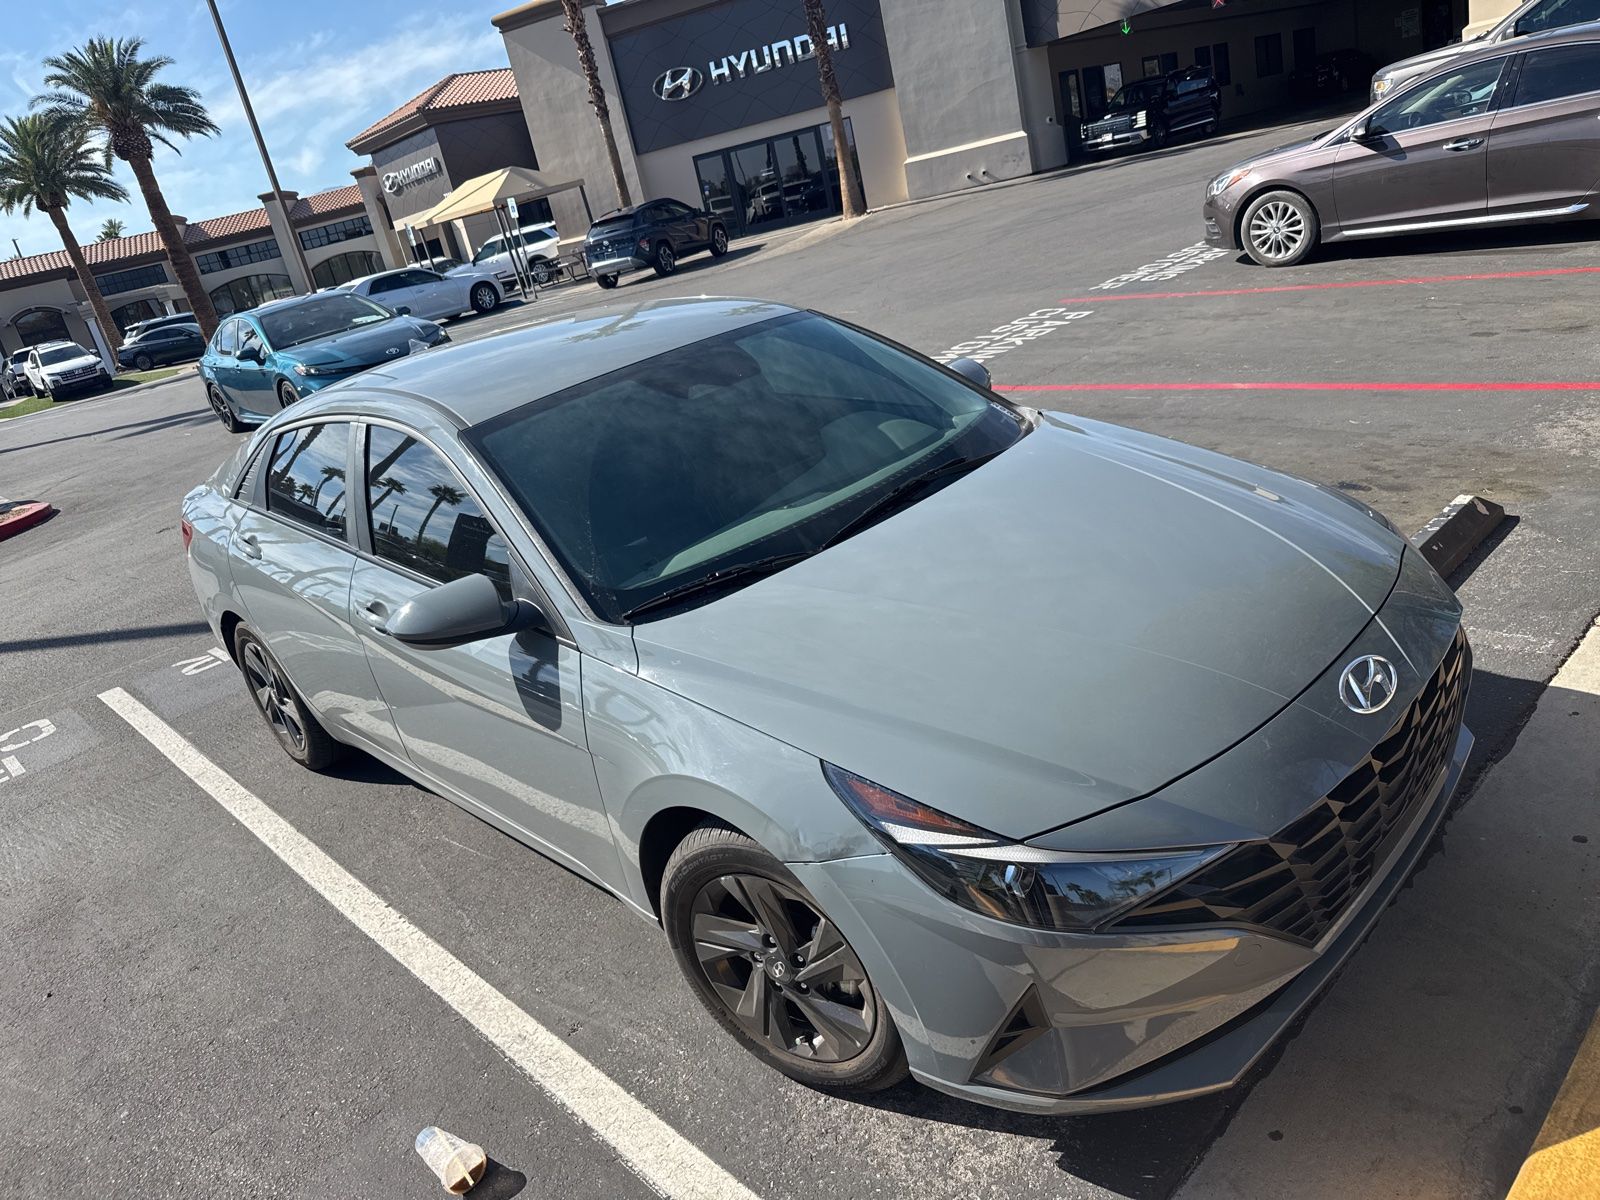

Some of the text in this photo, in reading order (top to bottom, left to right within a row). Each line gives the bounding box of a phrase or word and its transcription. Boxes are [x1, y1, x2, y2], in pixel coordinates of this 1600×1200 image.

[397, 156, 436, 187] HYUNDAI
[929, 307, 1067, 364] CUSTOM
[965, 310, 1095, 364] PARKIN
